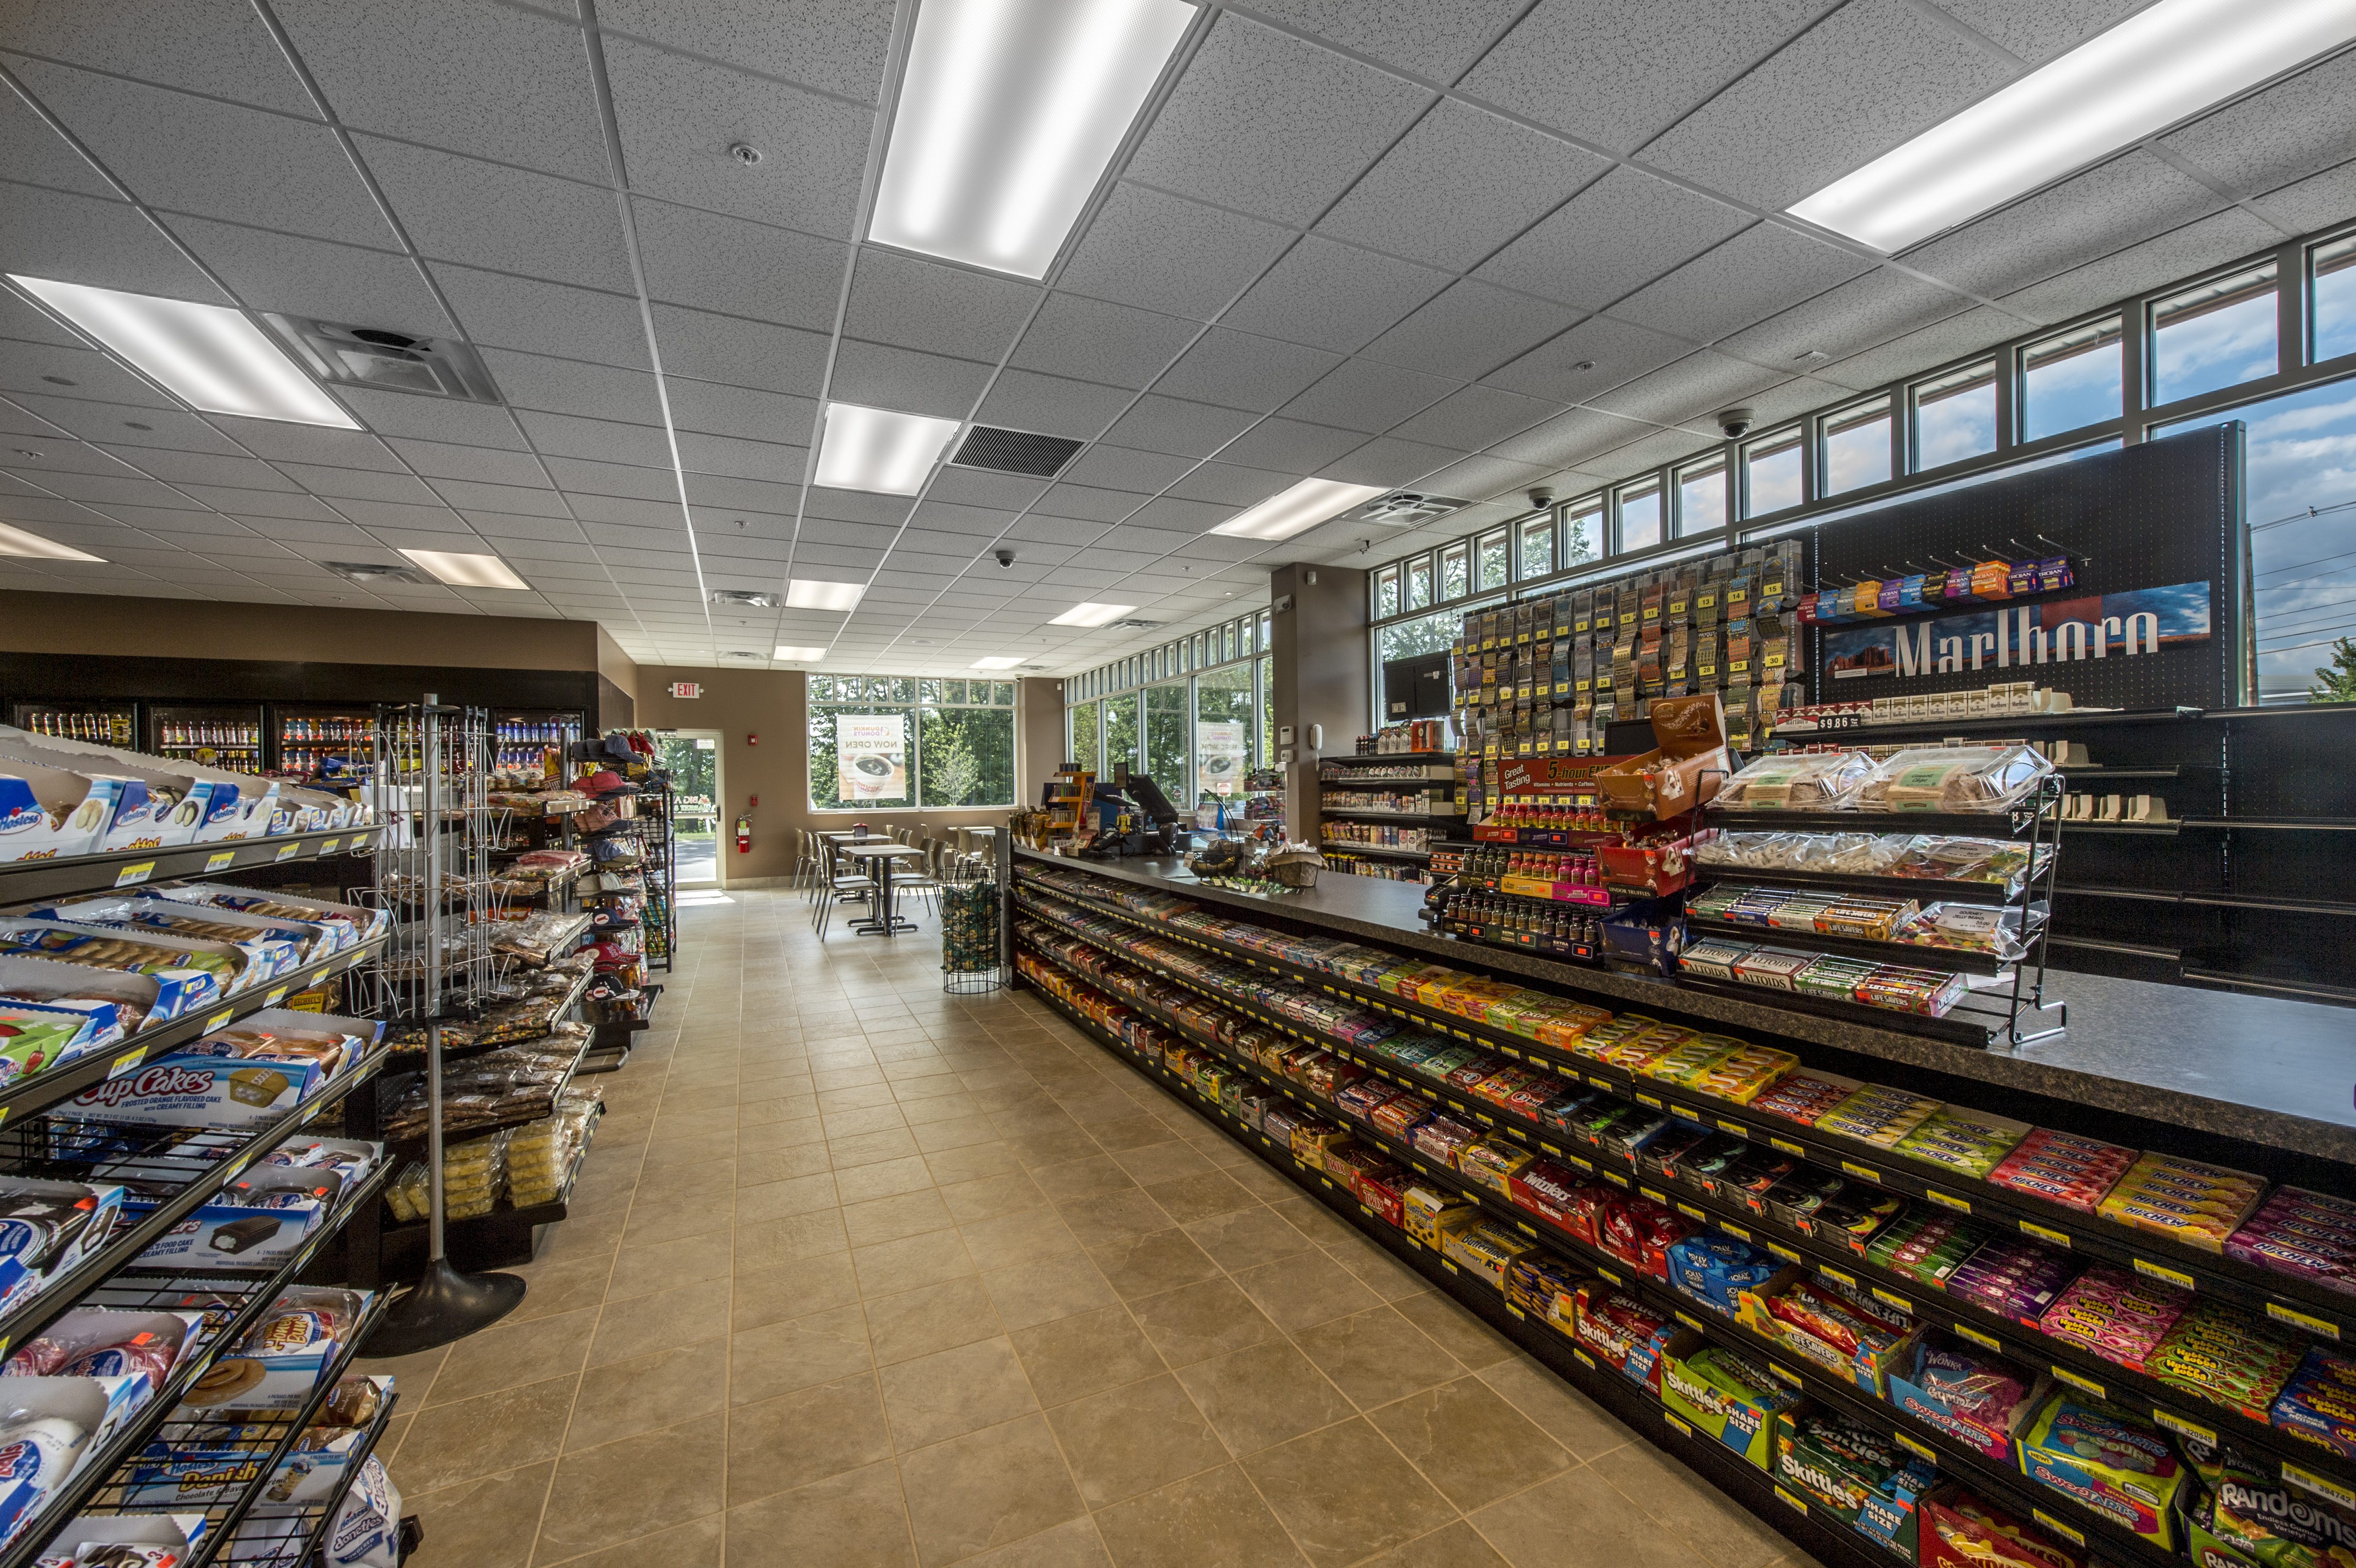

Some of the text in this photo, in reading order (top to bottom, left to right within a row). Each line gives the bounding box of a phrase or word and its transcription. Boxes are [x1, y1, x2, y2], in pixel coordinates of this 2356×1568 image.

[678, 684, 695, 696] EXIT
[1820, 718, 1848, 728] $9.86
[1505, 764, 1524, 779] Great
[1547, 761, 1588, 779] 5-hour
[1504, 774, 1530, 790] Tasting
[0, 814, 39, 831] Hostess
[122, 808, 147, 822] Hostess
[213, 809, 237, 820] Hostess
[1695, 948, 1735, 958] ALTOIDS
[1751, 957, 1794, 968] ALTOIDS
[1689, 964, 1727, 978] ALTOIDS
[1744, 973, 1786, 988] ALTOIDS
[1520, 1010, 1551, 1019] Extra
[1548, 1020, 1582, 1028] Extra
[90, 1027, 115, 1045] Hostess
[133, 1066, 215, 1098] Cakes
[1350, 1086, 1381, 1103] CRUNCH
[121, 1099, 148, 1108] FROSTED
[1339, 1100, 1365, 1119] CRUNCH
[1763, 1100, 1801, 1114] HI-CHEW
[1831, 1121, 1877, 1136] HI-CHEW
[1295, 1140, 1310, 1151] Twix
[1912, 1146, 1960, 1162] HI-CHEW
[1324, 1154, 1346, 1176] Twix
[1523, 1171, 1572, 1201] Twizzlers
[2009, 1175, 2067, 1194] HI-CHEW
[1363, 1190, 1385, 1211] Twix
[2132, 1195, 2199, 1215] HI-CHEW
[1406, 1201, 1433, 1222] Butterfinger
[1537, 1200, 1562, 1221] Twizzlers
[2122, 1206, 2191, 1227] HI-CHEW
[165, 1246, 189, 1255] FILLING
[1688, 1252, 1708, 1264] JOLLY
[2252, 1242, 2335, 1271] HI-CHEW
[1684, 1268, 1704, 1280] JOLLY
[287, 1315, 308, 1344] Bun
[2060, 1318, 2083, 1331] Hubba
[2073, 1324, 2096, 1338] Bubba
[264, 1316, 294, 1351] Honey
[1578, 1318, 1626, 1359] Skittles
[1628, 1349, 1654, 1367] SHARE
[1630, 1356, 1648, 1372] SIZE
[1926, 1351, 1963, 1371] WONKA
[1852, 1360, 1876, 1374] SHARE
[1855, 1367, 1874, 1380] SIZE
[2167, 1360, 2189, 1374] Hubba
[2184, 1367, 2208, 1382] Bubba
[1667, 1372, 1723, 1416] Skittles
[1725, 1405, 1762, 1430] SHARE
[1728, 1416, 1755, 1435] SIZE
[2185, 1428, 2214, 1444] 320945
[2030, 1450, 2051, 1465] NEW!
[170, 1462, 216, 1474] Hostess
[1781, 1454, 1858, 1510] Skittles
[176, 1491, 215, 1502] Chocolate
[2319, 1484, 2352, 1503] 394742
[340, 1506, 369, 1529] Hostess
[1864, 1498, 1902, 1527] SHARE
[1867, 1509, 1893, 1531] SIZE
[2257, 1513, 2283, 1526] Endless
[334, 1515, 384, 1552] donettes
[345, 1538, 374, 1560] POWDERED
